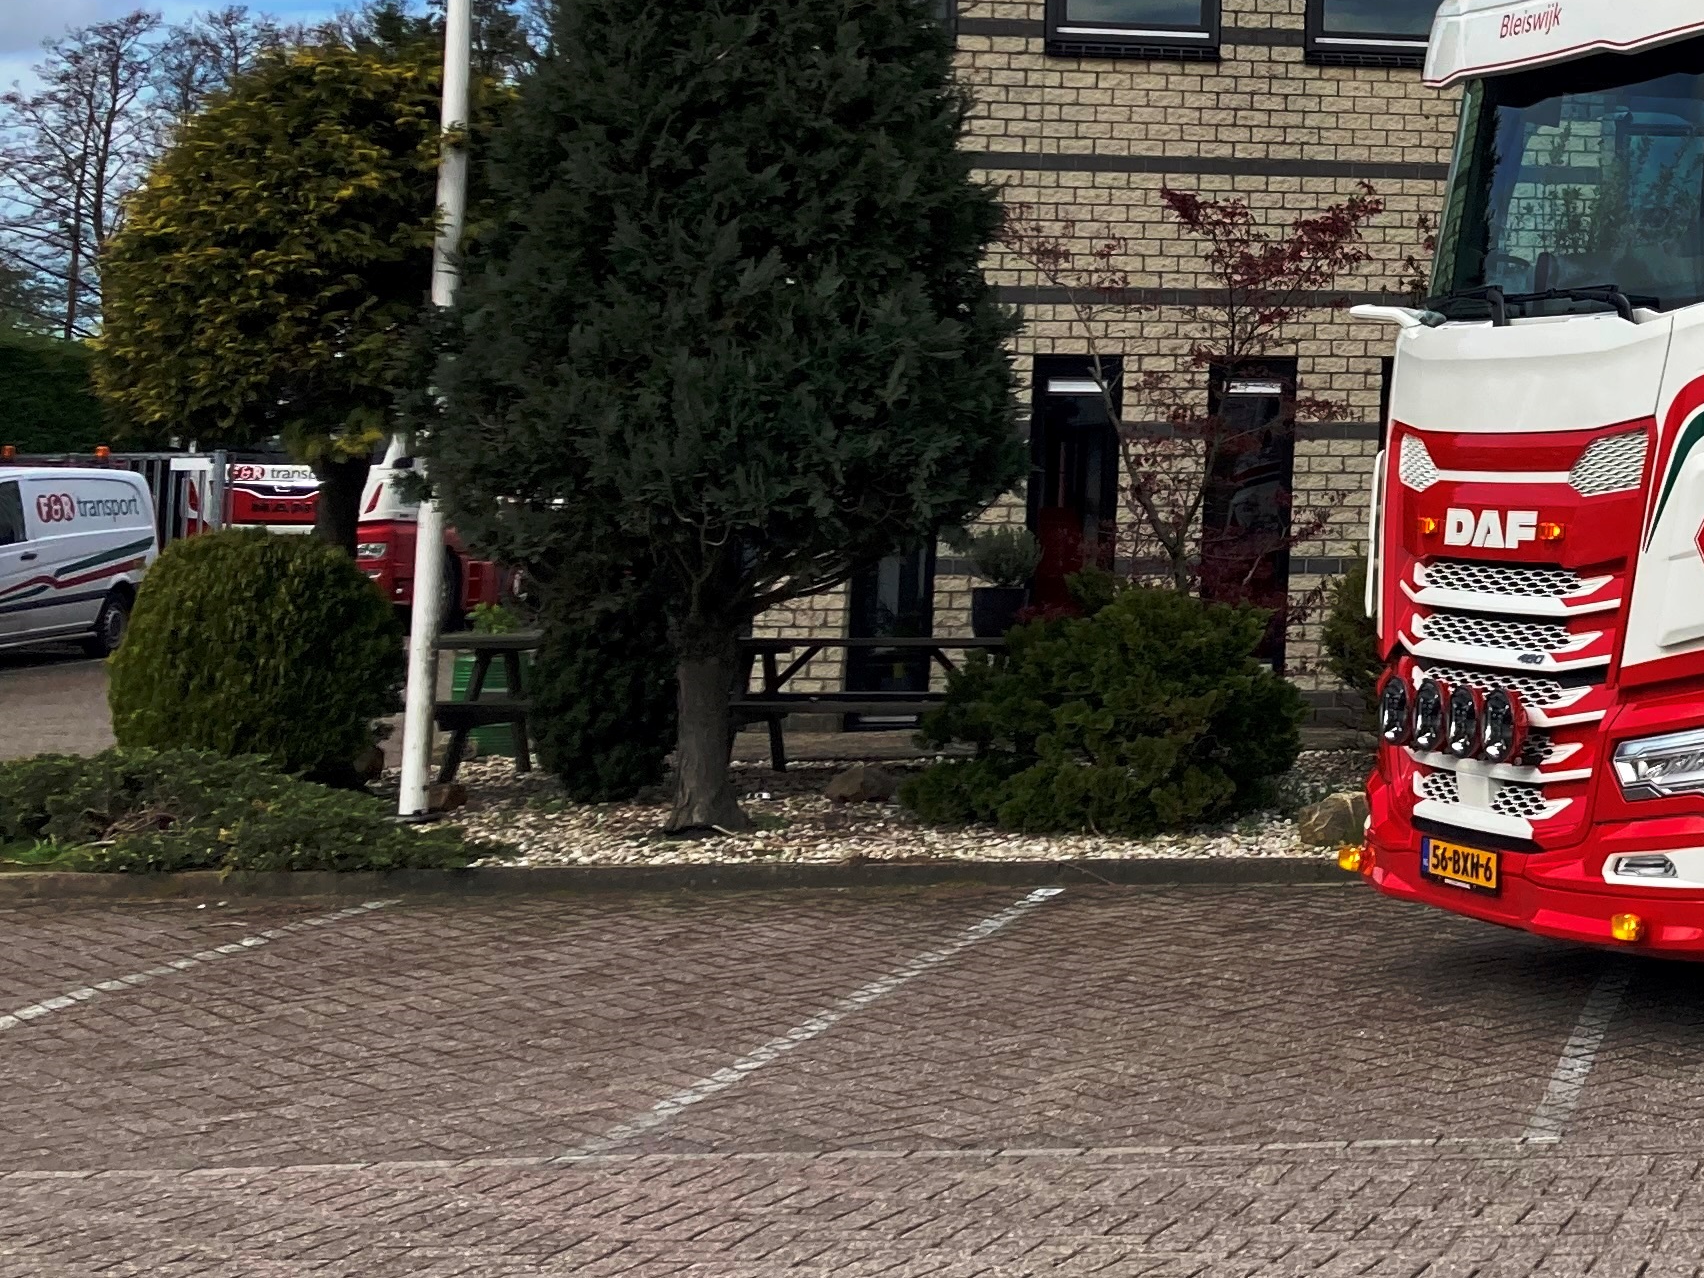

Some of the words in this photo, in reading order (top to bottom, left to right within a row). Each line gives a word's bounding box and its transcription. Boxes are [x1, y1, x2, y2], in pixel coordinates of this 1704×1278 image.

[1499, 2, 1562, 39] Bleiswijk
[270, 468, 317, 480] transp
[37, 492, 75, 523] F&R
[76, 495, 140, 522] transport
[1443, 507, 1538, 549] DAF
[1431, 844, 1493, 882] 56-BXH-6
